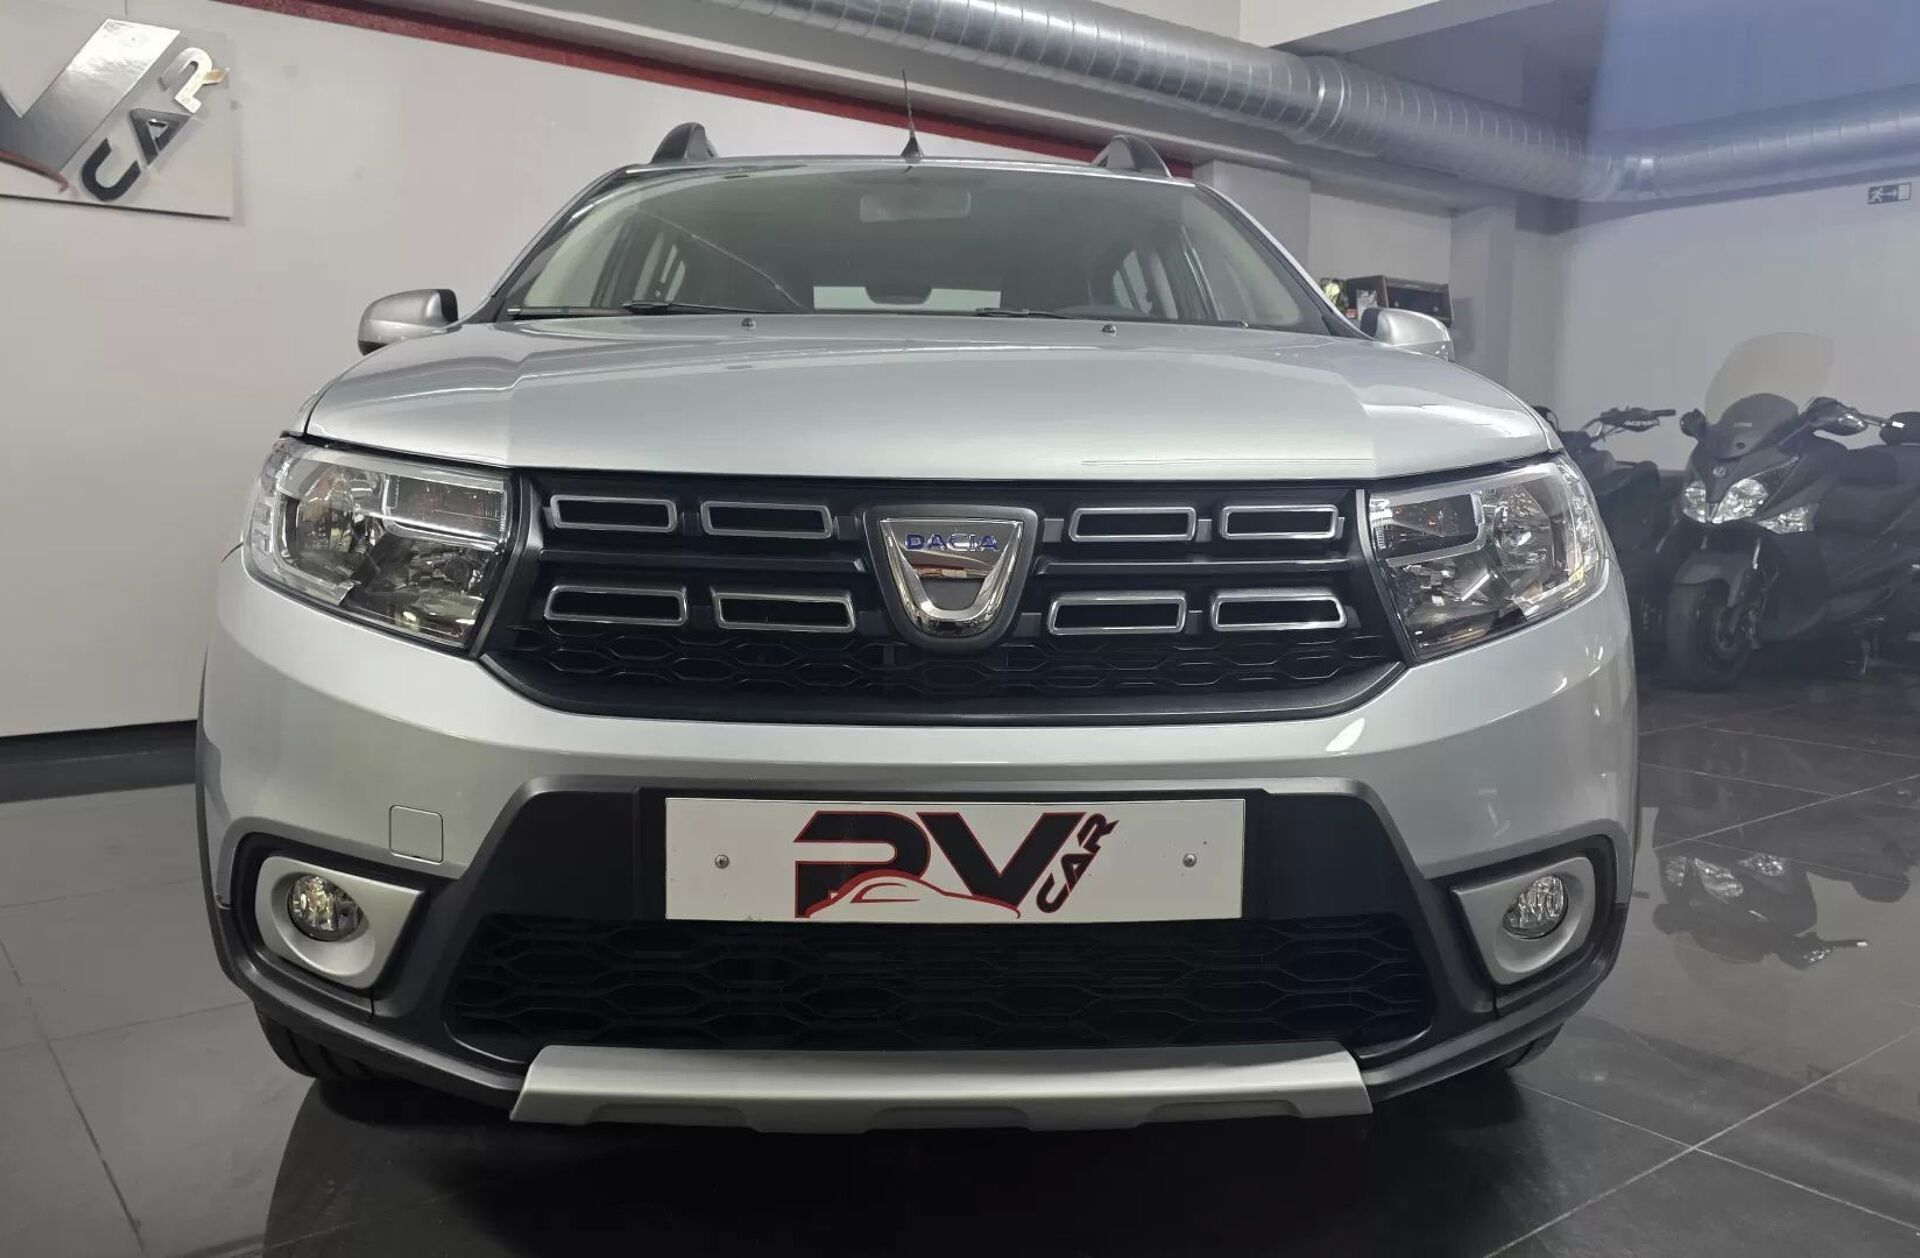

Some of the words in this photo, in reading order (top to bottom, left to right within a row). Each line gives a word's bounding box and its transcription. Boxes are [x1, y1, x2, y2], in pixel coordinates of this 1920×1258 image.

[82, 47, 230, 201] CAR
[905, 533, 998, 551] DACIA
[1036, 813, 1120, 913] CAR
